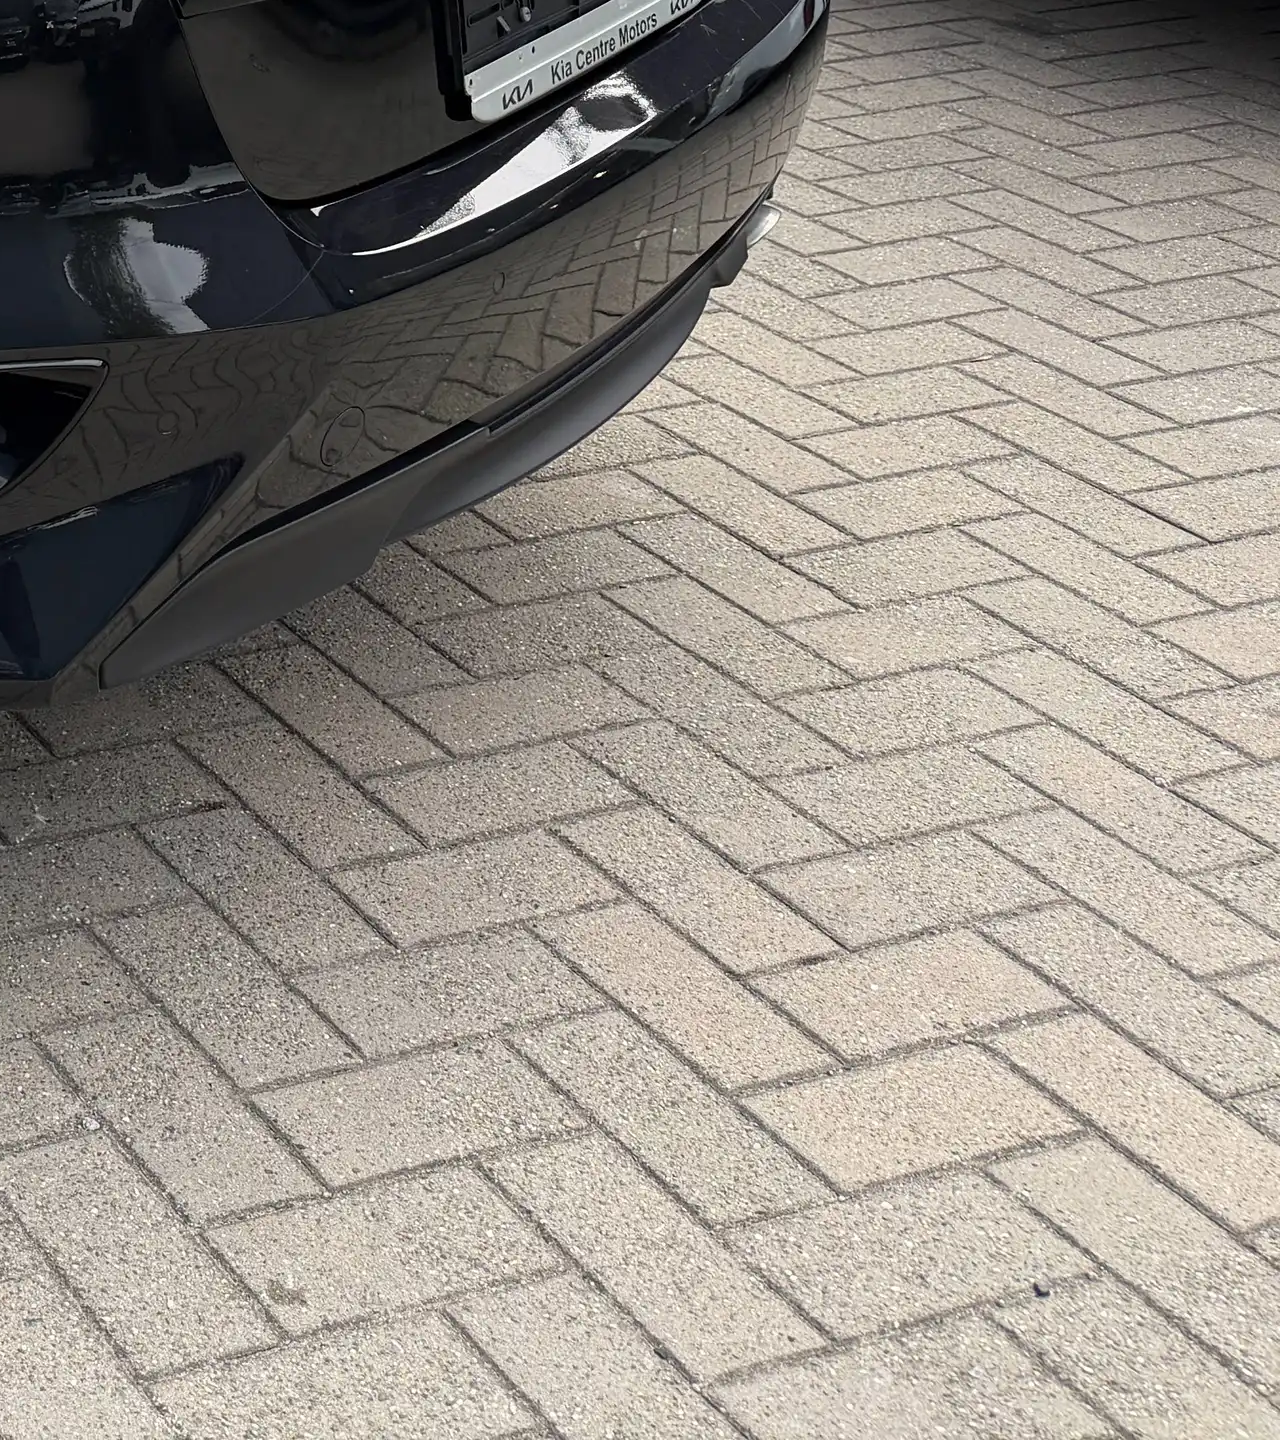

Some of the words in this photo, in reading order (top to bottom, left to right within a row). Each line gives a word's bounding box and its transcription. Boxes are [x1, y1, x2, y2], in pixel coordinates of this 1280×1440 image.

[502, 78, 534, 110] KIA
[551, 60, 573, 85] Kia
[575, 37, 617, 71] Centre
[618, 12, 658, 48] Motors
